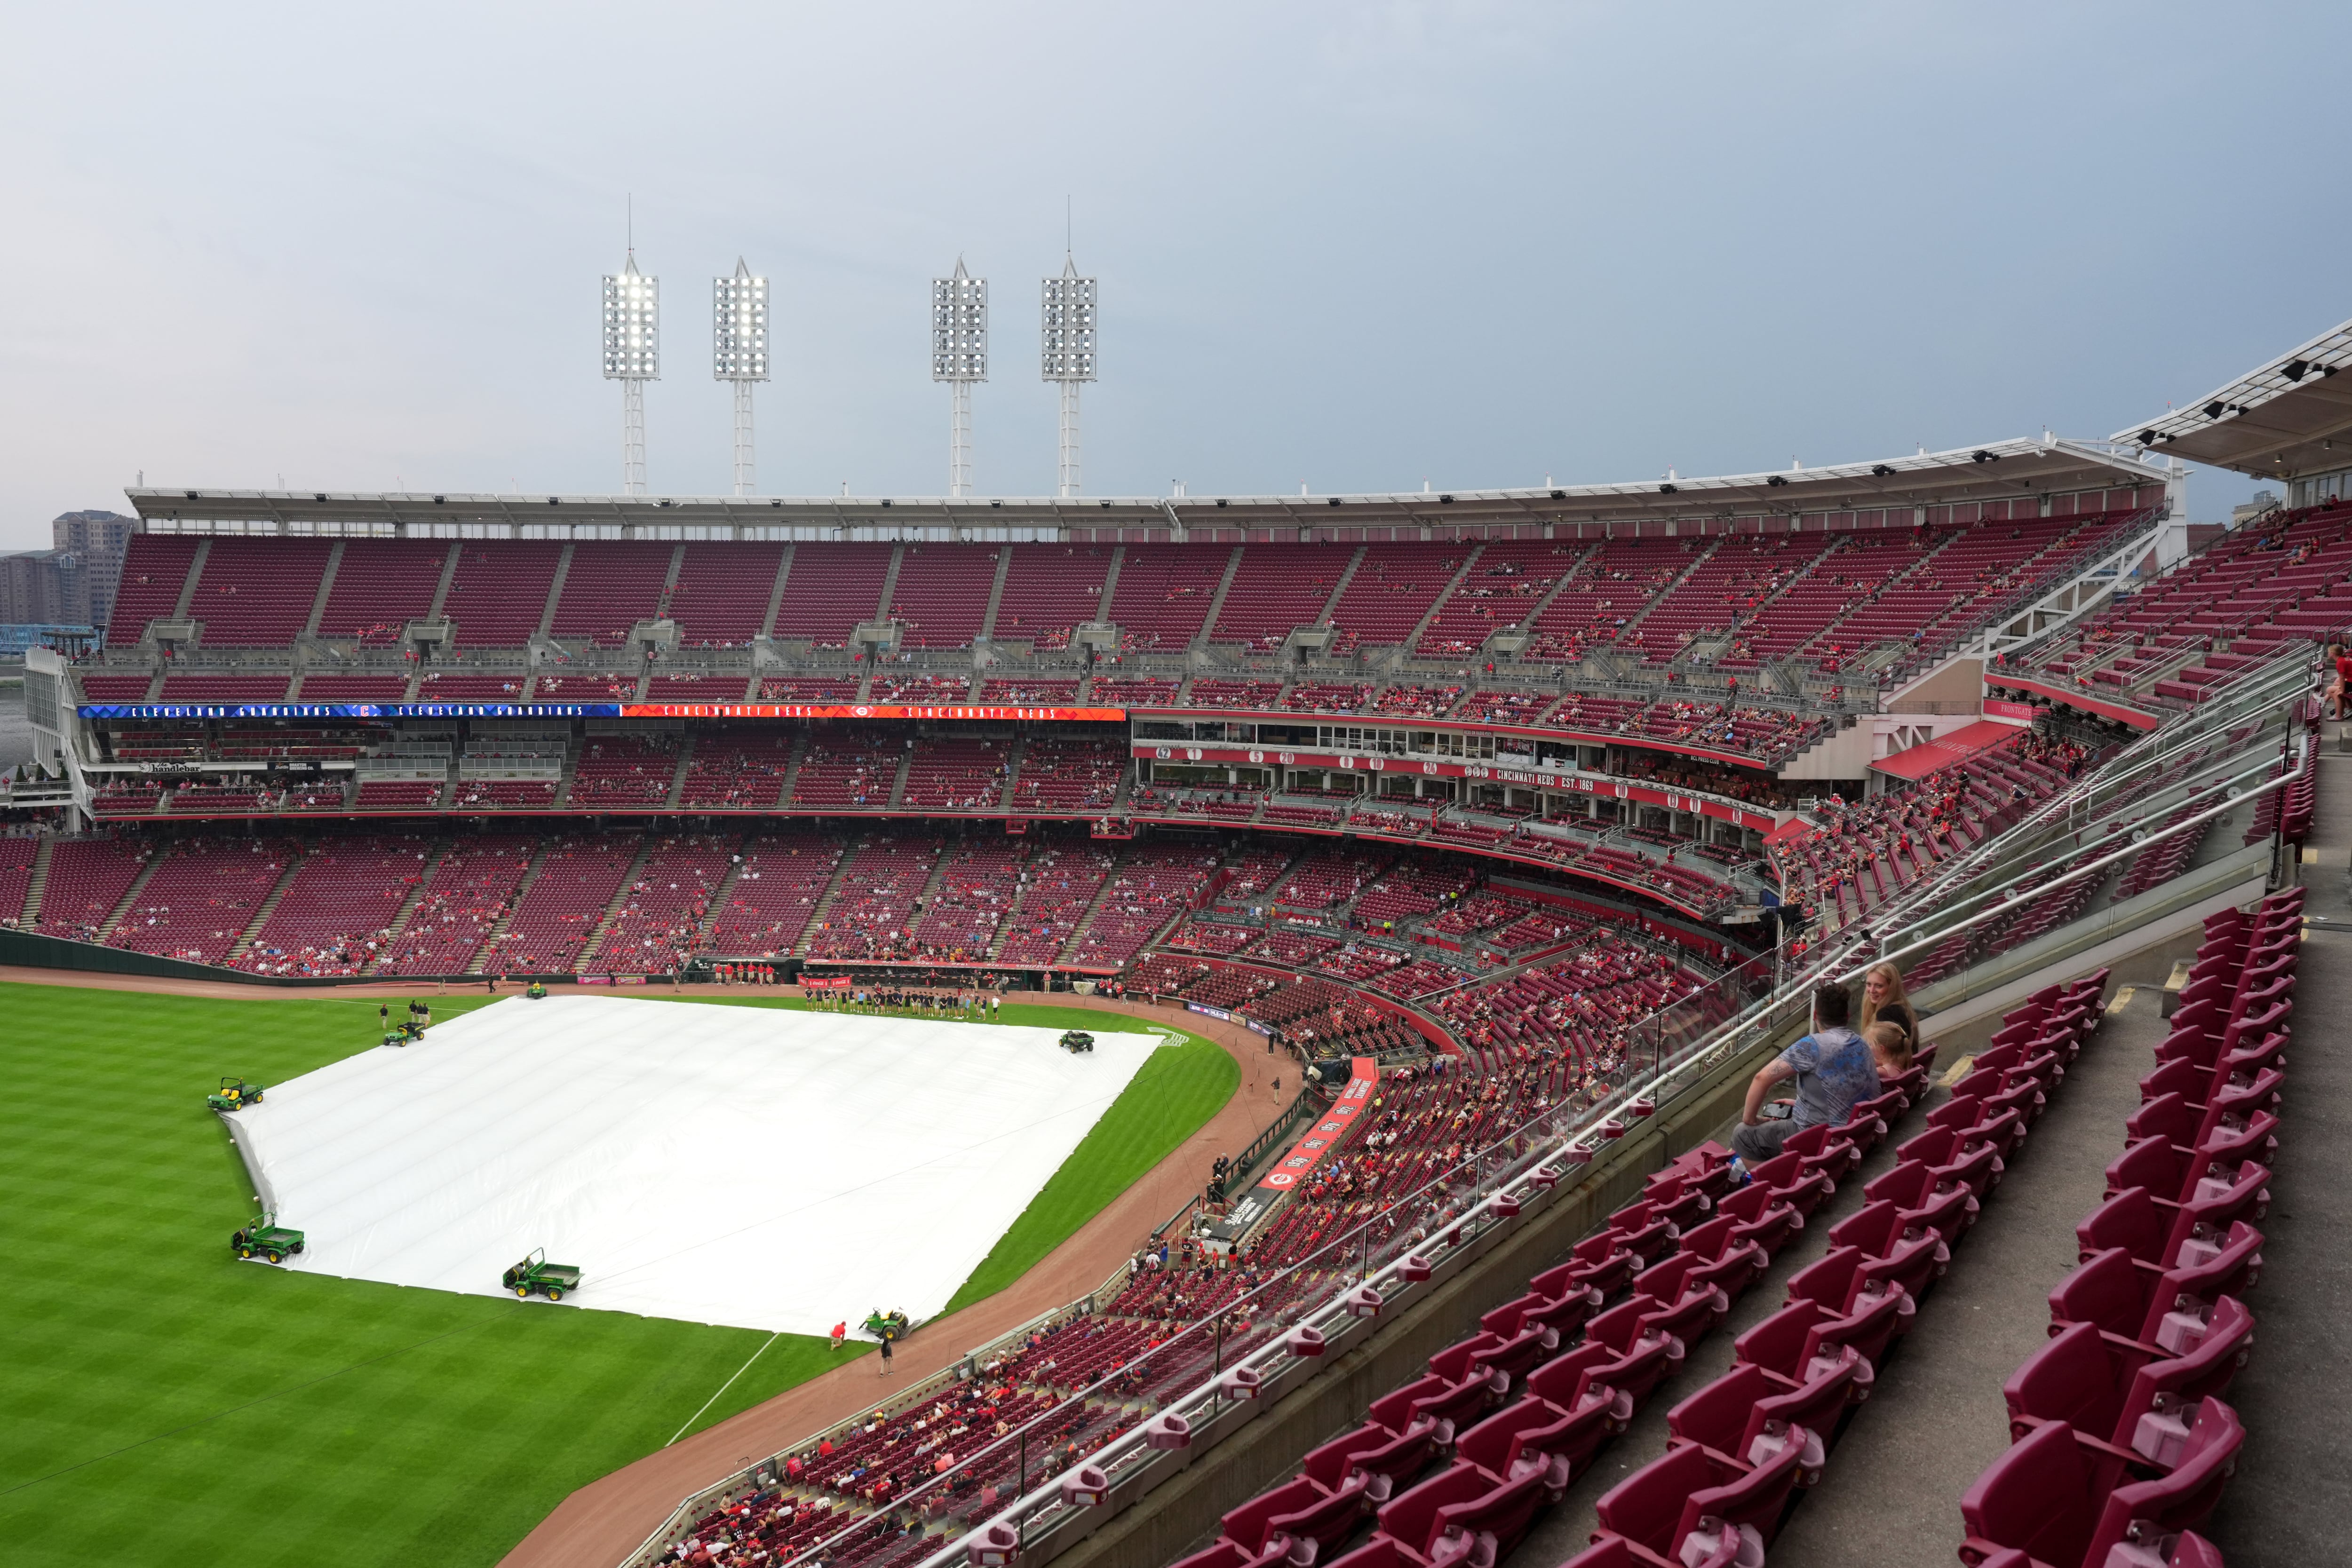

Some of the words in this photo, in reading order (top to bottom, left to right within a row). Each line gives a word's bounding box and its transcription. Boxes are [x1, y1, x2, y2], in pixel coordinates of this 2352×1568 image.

[132, 707, 224, 717] CLEVELAND
[239, 707, 329, 716] GUARDIANS
[399, 706, 484, 715] CLEVELAND
[498, 706, 582, 715] GUARDIANS
[665, 706, 760, 715] CINCINNATI
[775, 706, 811, 716] REDS
[908, 707, 1003, 718] CINCINNATI
[1018, 709, 1054, 719] REDS
[2001, 704, 2032, 716] FRONTGATE
[1158, 748, 1168, 758] 42
[1192, 749, 1196, 759] 1
[1254, 752, 1259, 761] 5
[1282, 752, 1292, 763] 20
[1344, 757, 1349, 767] 8
[1373, 758, 1381, 769] 18
[1425, 762, 1435, 773] 24
[151, 764, 200, 772] handlebar
[1497, 769, 1535, 784] CINCINNATI
[1537, 774, 1555, 786] REDS
[1561, 777, 1577, 788] EST.
[1579, 779, 1593, 792] 1869
[1617, 784, 1625, 798] 10
[1304, 1139, 1323, 1149] 1961
[1287, 1156, 1308, 1168] 1939
[1224, 1213, 1245, 1226] Reds
[1235, 1196, 1254, 1213] COUNTRY
[1242, 1202, 1256, 1214] CARES
